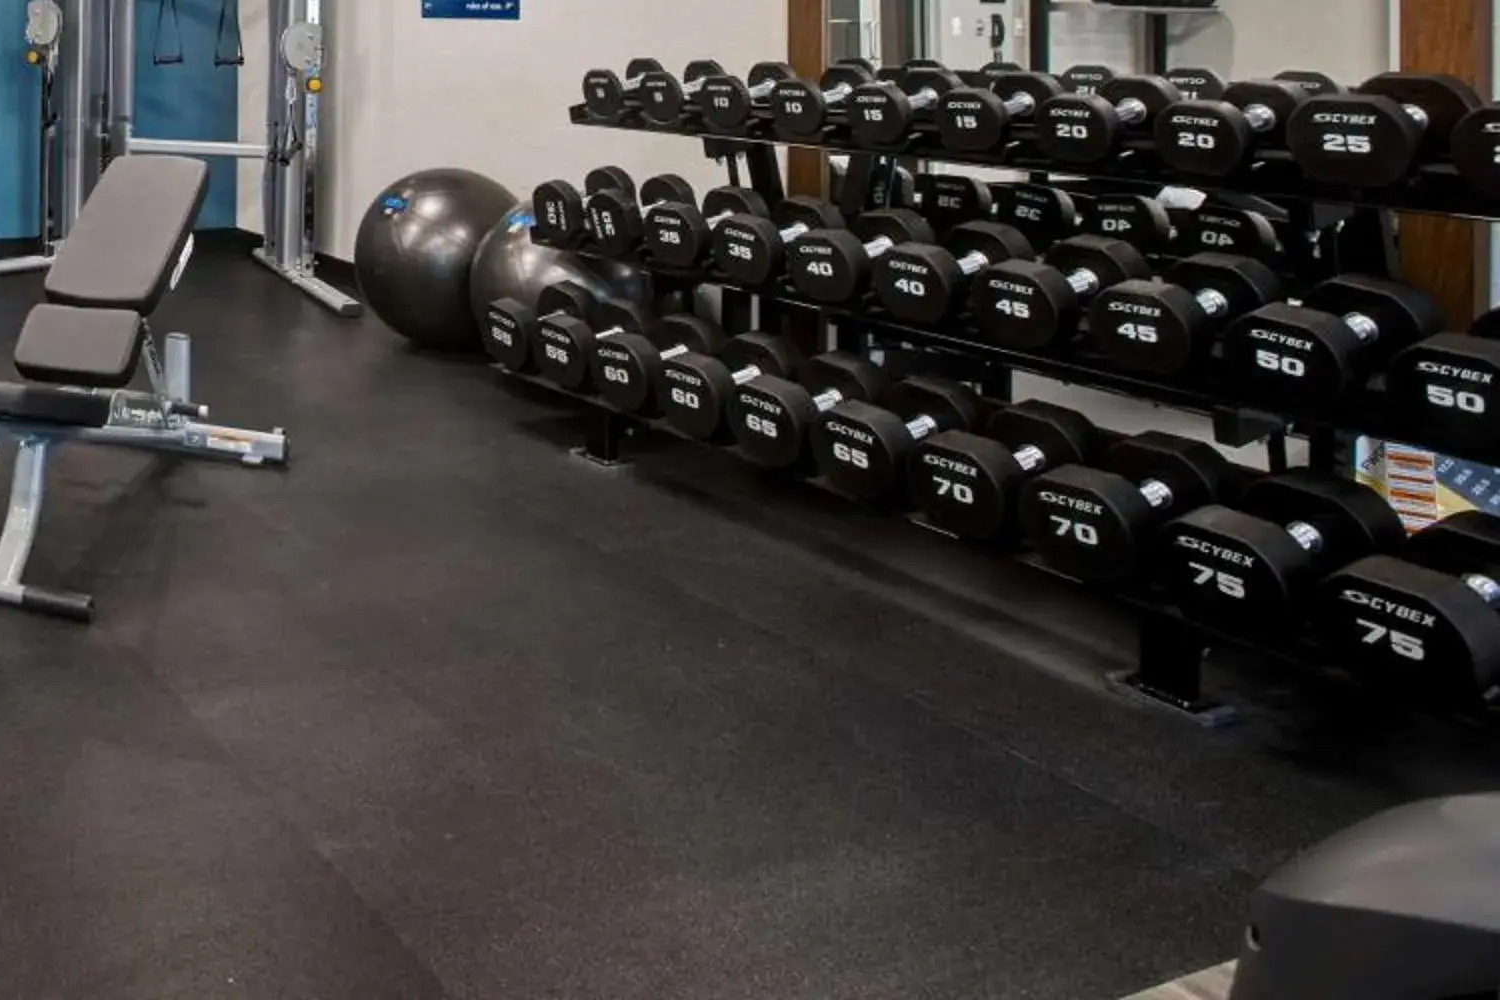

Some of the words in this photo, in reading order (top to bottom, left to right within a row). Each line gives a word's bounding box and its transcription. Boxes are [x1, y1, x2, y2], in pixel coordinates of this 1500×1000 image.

[785, 101, 802, 113] 10
[864, 109, 882, 121] 15
[956, 115, 977, 129] 15
[1330, 113, 1378, 125] CYBEX
[1056, 123, 1088, 139] 20
[1178, 132, 1215, 150] 20
[1322, 133, 1371, 153] 25
[659, 229, 681, 245] 35
[727, 244, 753, 261] 35
[806, 261, 834, 277] 40
[894, 278, 926, 297] 40
[995, 299, 1031, 319] 45
[1123, 303, 1162, 317] CYBEX
[1116, 323, 1160, 344] 45
[1266, 331, 1314, 351] CYBEX
[1255, 348, 1305, 377] 50
[604, 365, 629, 384] 60
[1438, 364, 1493, 384] CYBEX
[671, 388, 699, 409] 60
[1427, 383, 1486, 414] 50
[745, 413, 778, 438] 65
[833, 441, 869, 470] 65
[932, 475, 974, 505] 70
[1055, 495, 1104, 516] CYBEX
[1049, 515, 1099, 546] 70
[1198, 541, 1255, 569] CYBEX
[1188, 561, 1245, 599] 75
[1369, 597, 1437, 628] CYBEX
[1356, 617, 1426, 662] 75
